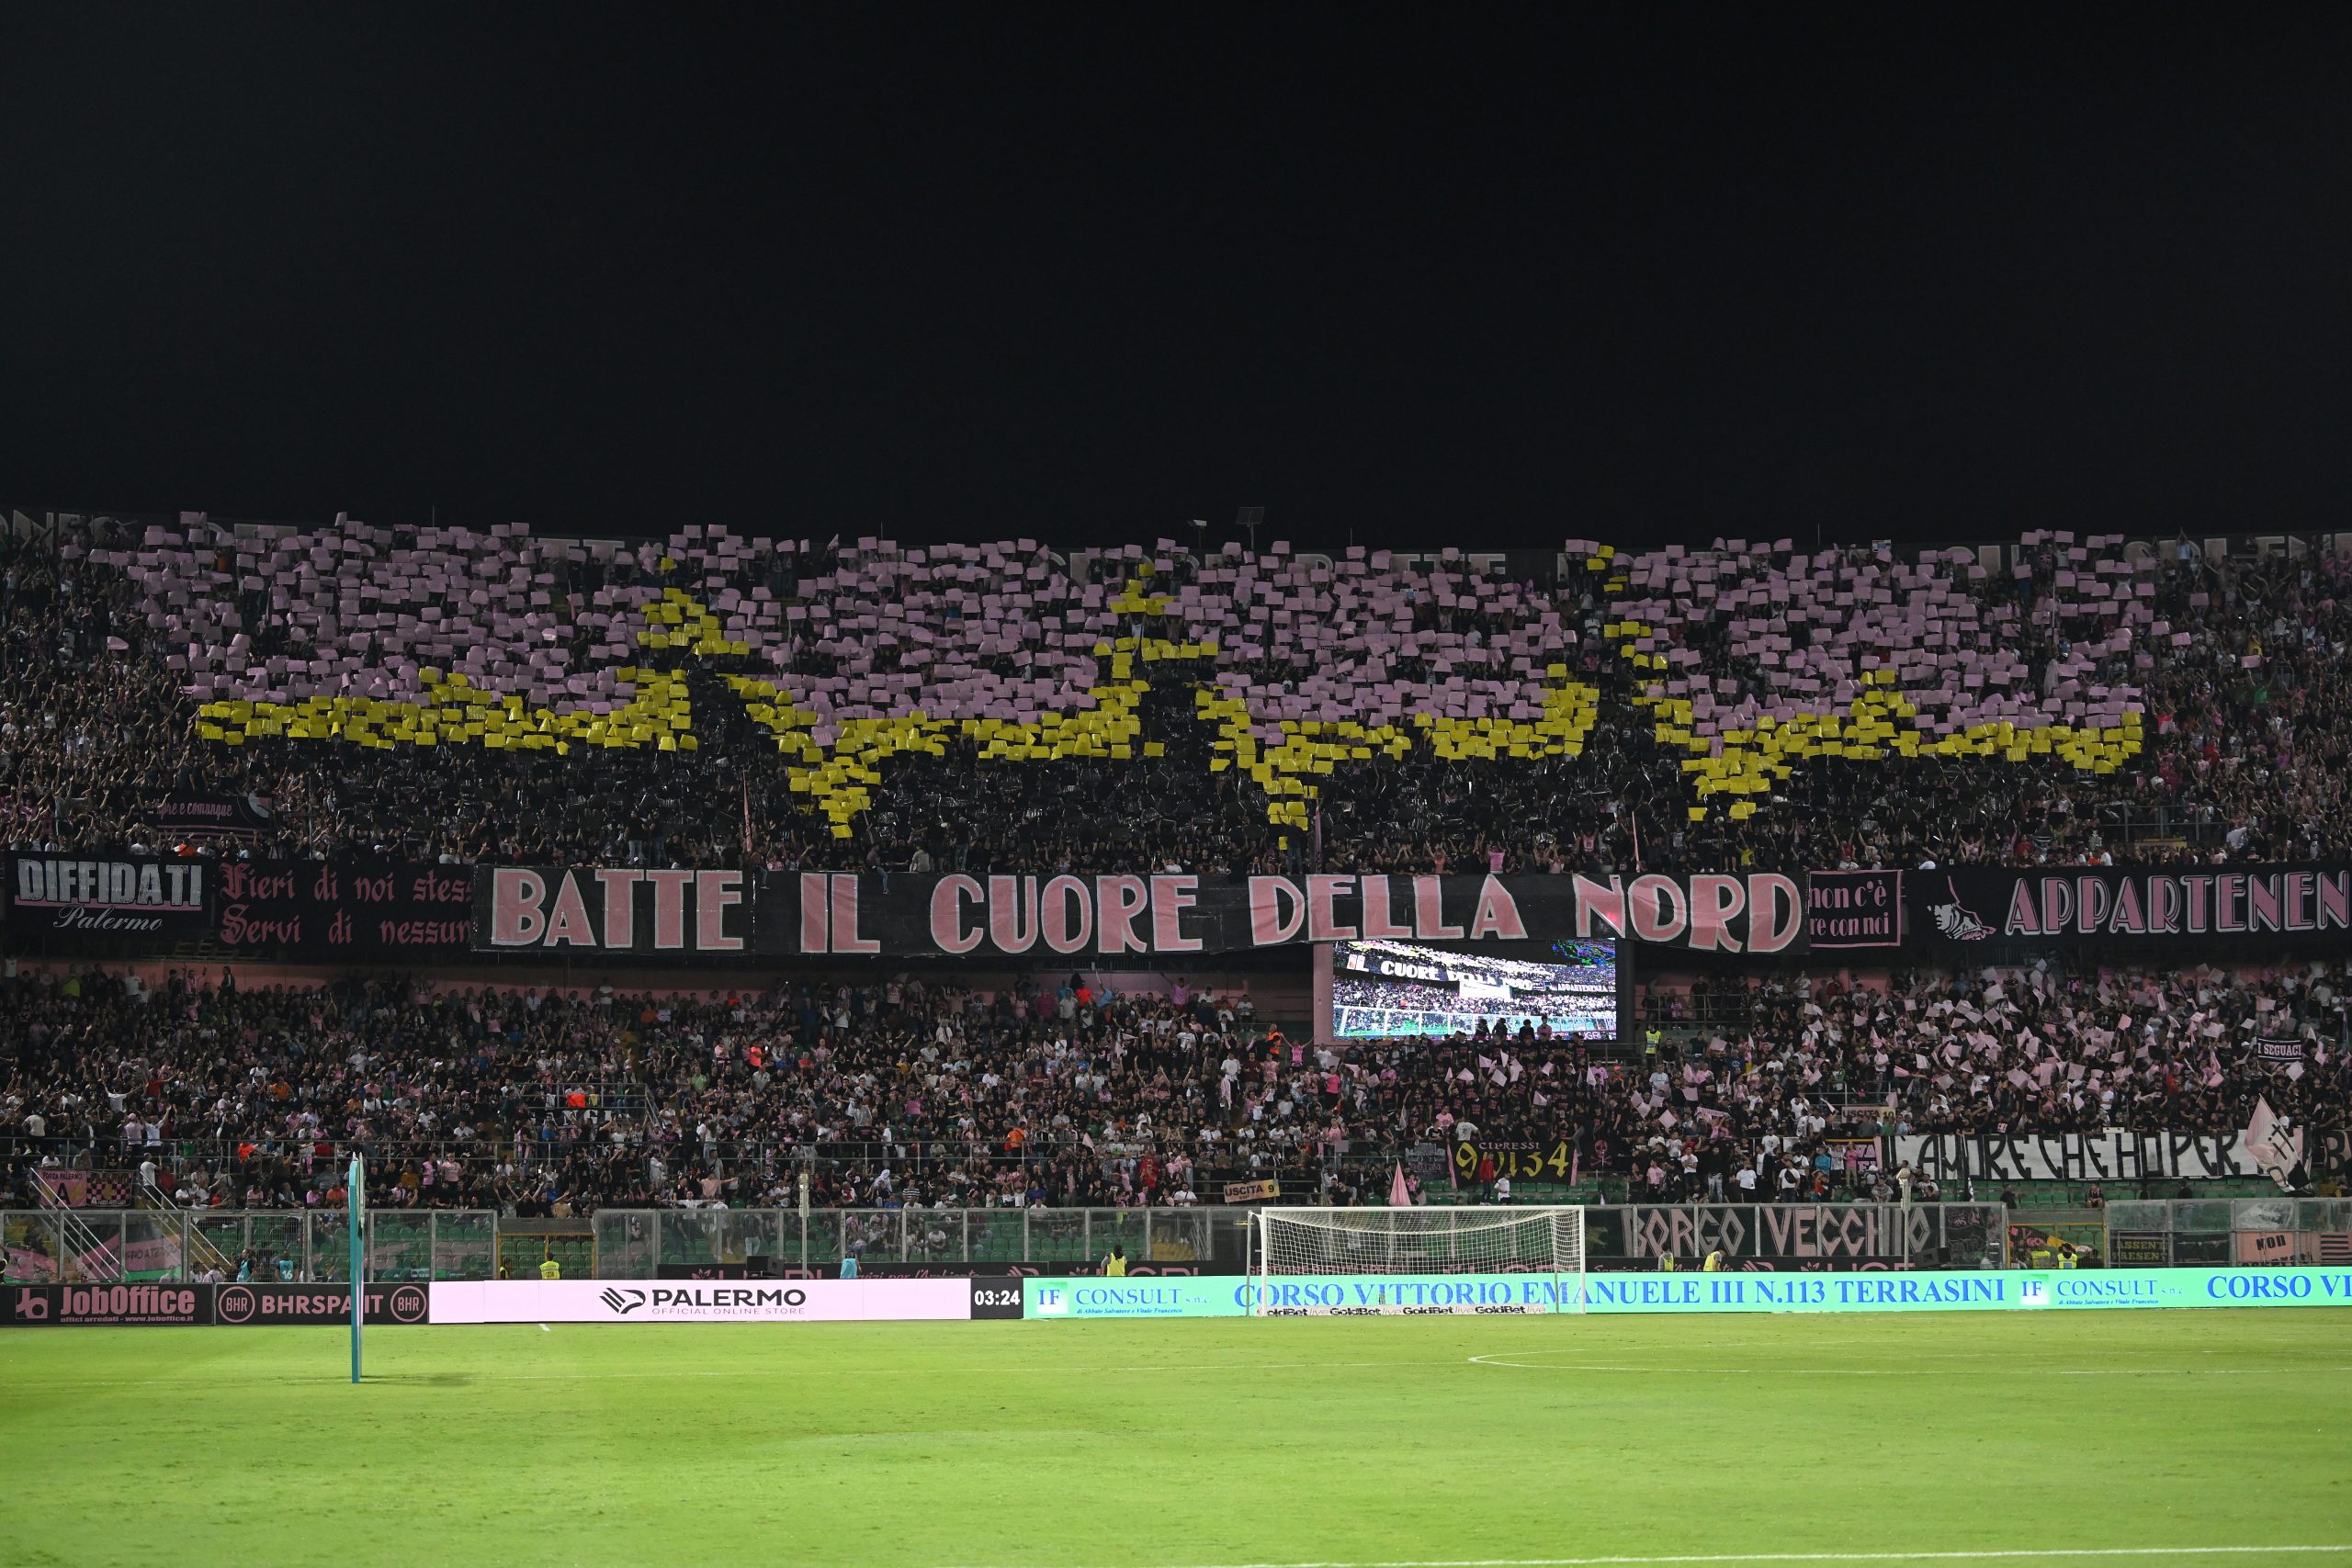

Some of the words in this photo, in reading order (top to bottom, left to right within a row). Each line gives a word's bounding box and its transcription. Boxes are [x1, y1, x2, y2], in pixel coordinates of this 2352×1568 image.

[17, 858, 202, 906] DIFFIDATI
[220, 863, 295, 900] Fieri
[313, 863, 338, 901] di
[354, 873, 394, 902] noi
[53, 904, 163, 931] Palermo
[492, 867, 743, 951] BATTE
[800, 874, 880, 953] IL
[930, 874, 1203, 953] CUORE
[1248, 874, 1526, 945] DELLA
[1574, 873, 1803, 953] NORD
[220, 903, 301, 945] Servi
[328, 908, 353, 944] di
[1830, 919, 1860, 937] con
[1863, 912, 1889, 935] noi
[1381, 960, 1441, 981] CUORE
[2264, 1043, 2301, 1055] SEGUACI
[1842, 1110, 1881, 1118] USCITA
[1478, 1142, 1540, 1150] CIPRESSI
[2168, 1130, 2241, 1177] PER
[1225, 1185, 1263, 1196] USCITA
[1621, 1207, 1745, 1258] BORGO
[1762, 1207, 1930, 1257] VECCHIO
[282, 1269, 293, 1280] 16
[1234, 1283, 1344, 1307] CORSO
[1356, 1281, 1511, 1306] VITTORIO
[1523, 1280, 1700, 1304] EMANUELE
[1713, 1281, 1743, 1303] III
[1755, 1281, 1825, 1303] N.113
[1835, 1279, 2005, 1303] TERRASINI
[2021, 1280, 2042, 1297] IF
[2057, 1280, 2157, 1296] CONSULT
[2207, 1275, 2312, 1298] CORSO
[60, 1286, 196, 1315] JobOffice
[226, 1297, 248, 1312] BHR
[398, 1296, 420, 1312] BHR
[652, 1289, 806, 1306] PALERMO
[974, 1290, 1020, 1305] 03:24
[1038, 1289, 1060, 1305] IF
[1076, 1289, 1182, 1304] CONSULT
[1402, 1306, 1453, 1314] GoldBet
[1475, 1305, 1526, 1314] GoldBet
